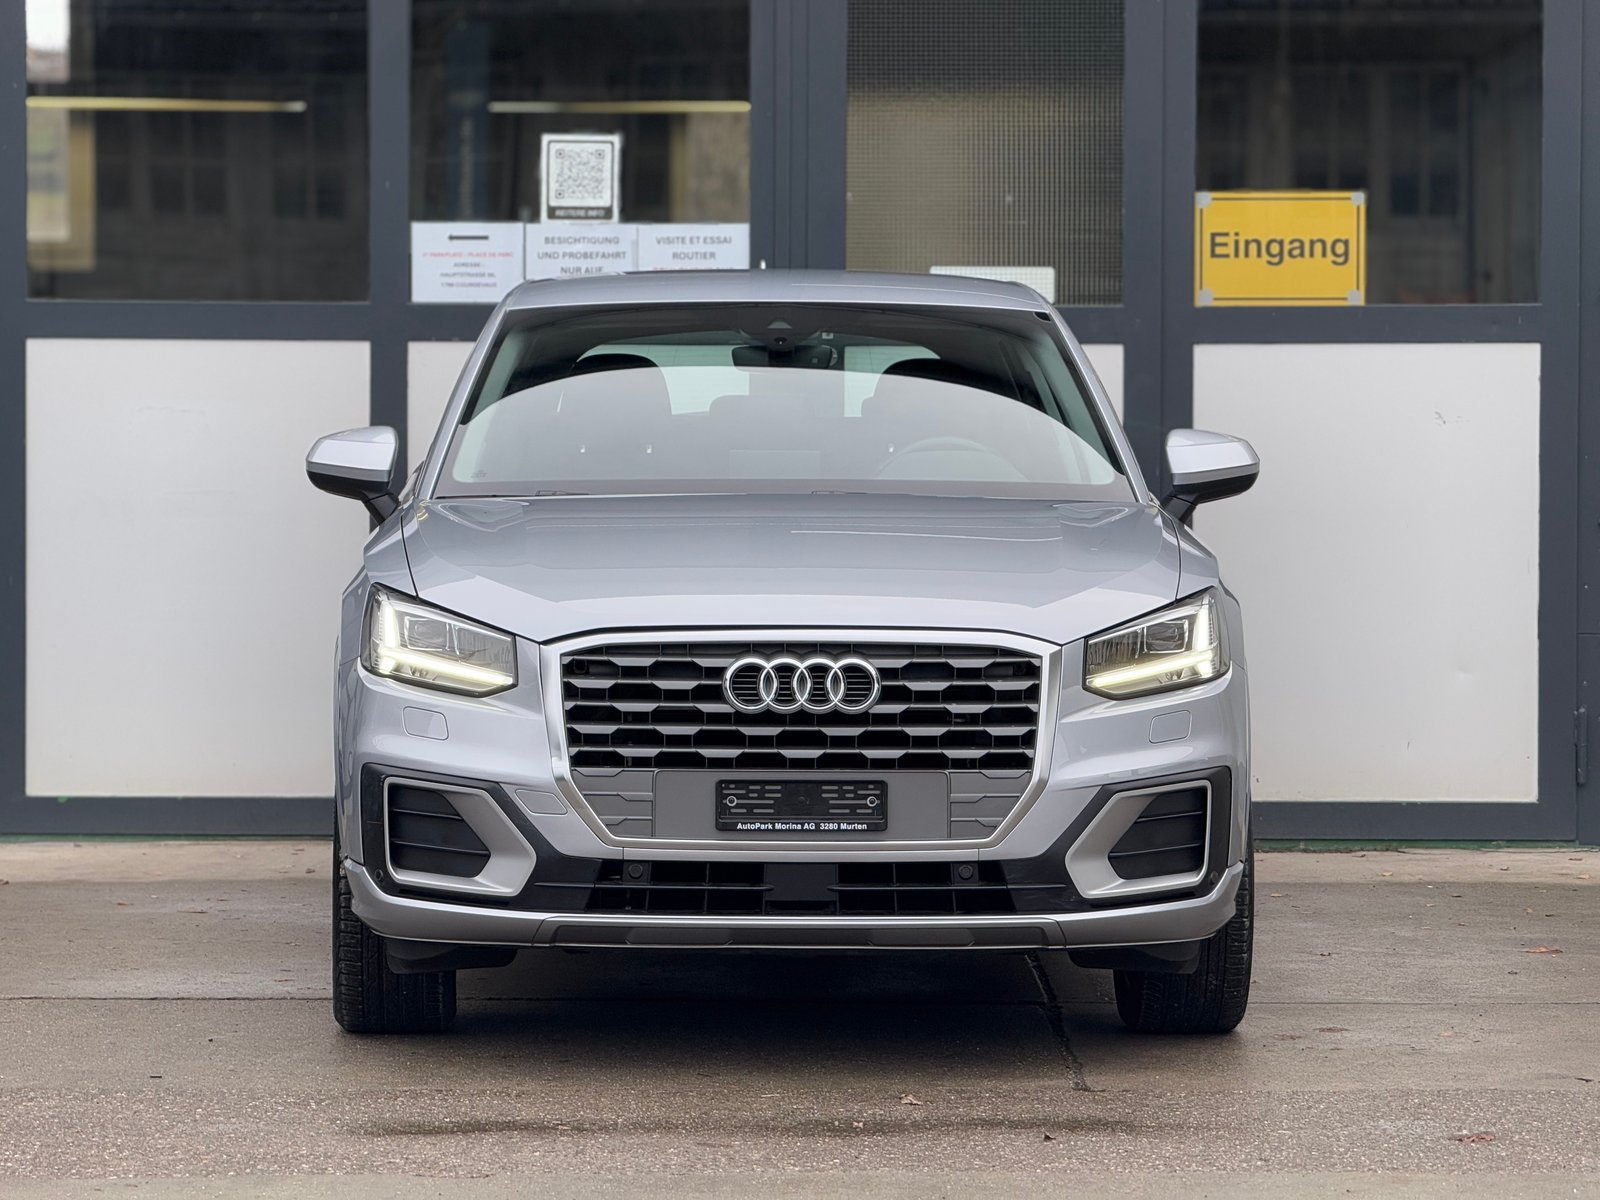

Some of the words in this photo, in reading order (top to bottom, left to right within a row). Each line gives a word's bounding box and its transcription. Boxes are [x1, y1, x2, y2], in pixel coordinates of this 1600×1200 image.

[544, 236, 619, 245] BESICHTIGUNG
[655, 236, 687, 245] VISITE
[689, 236, 701, 245] ET
[703, 236, 732, 245] ESSAI
[1210, 232, 1350, 266] Eingang
[537, 251, 560, 260] UND
[562, 251, 626, 260] PROBEFAHRT
[672, 251, 716, 260] ROUTIER
[560, 266, 582, 275] NUR
[737, 822, 773, 830] AutoPark
[774, 822, 802, 830] Morina
[803, 822, 816, 830] AG
[819, 822, 838, 830] 3280
[840, 822, 867, 830] Murten
